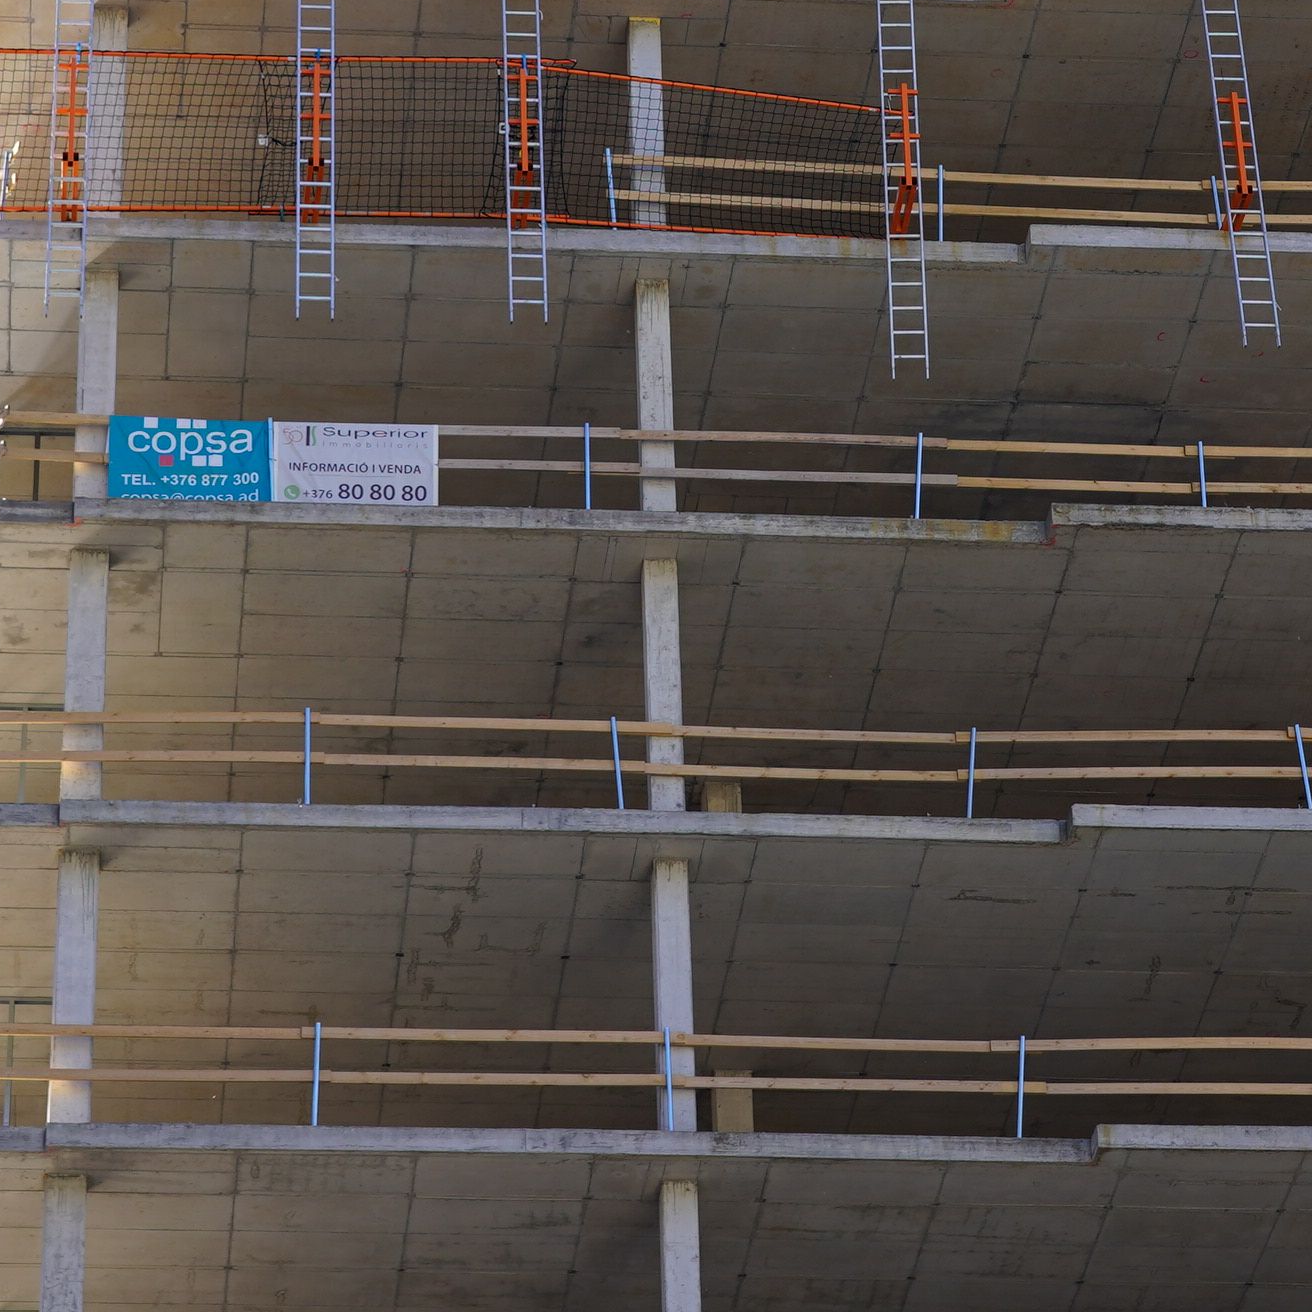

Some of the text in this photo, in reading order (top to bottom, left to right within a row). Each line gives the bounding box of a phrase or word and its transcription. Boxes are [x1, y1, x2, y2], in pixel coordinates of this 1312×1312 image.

[322, 426, 429, 440] Superior
[127, 428, 253, 461] copsa
[288, 462, 369, 474] INFORMACIÓ
[379, 464, 422, 475] VENDA
[121, 472, 259, 487] TEL. +376 877 300
[121, 489, 260, 502] cosa@cosaad
[303, 484, 427, 502] +376 80 80 80
